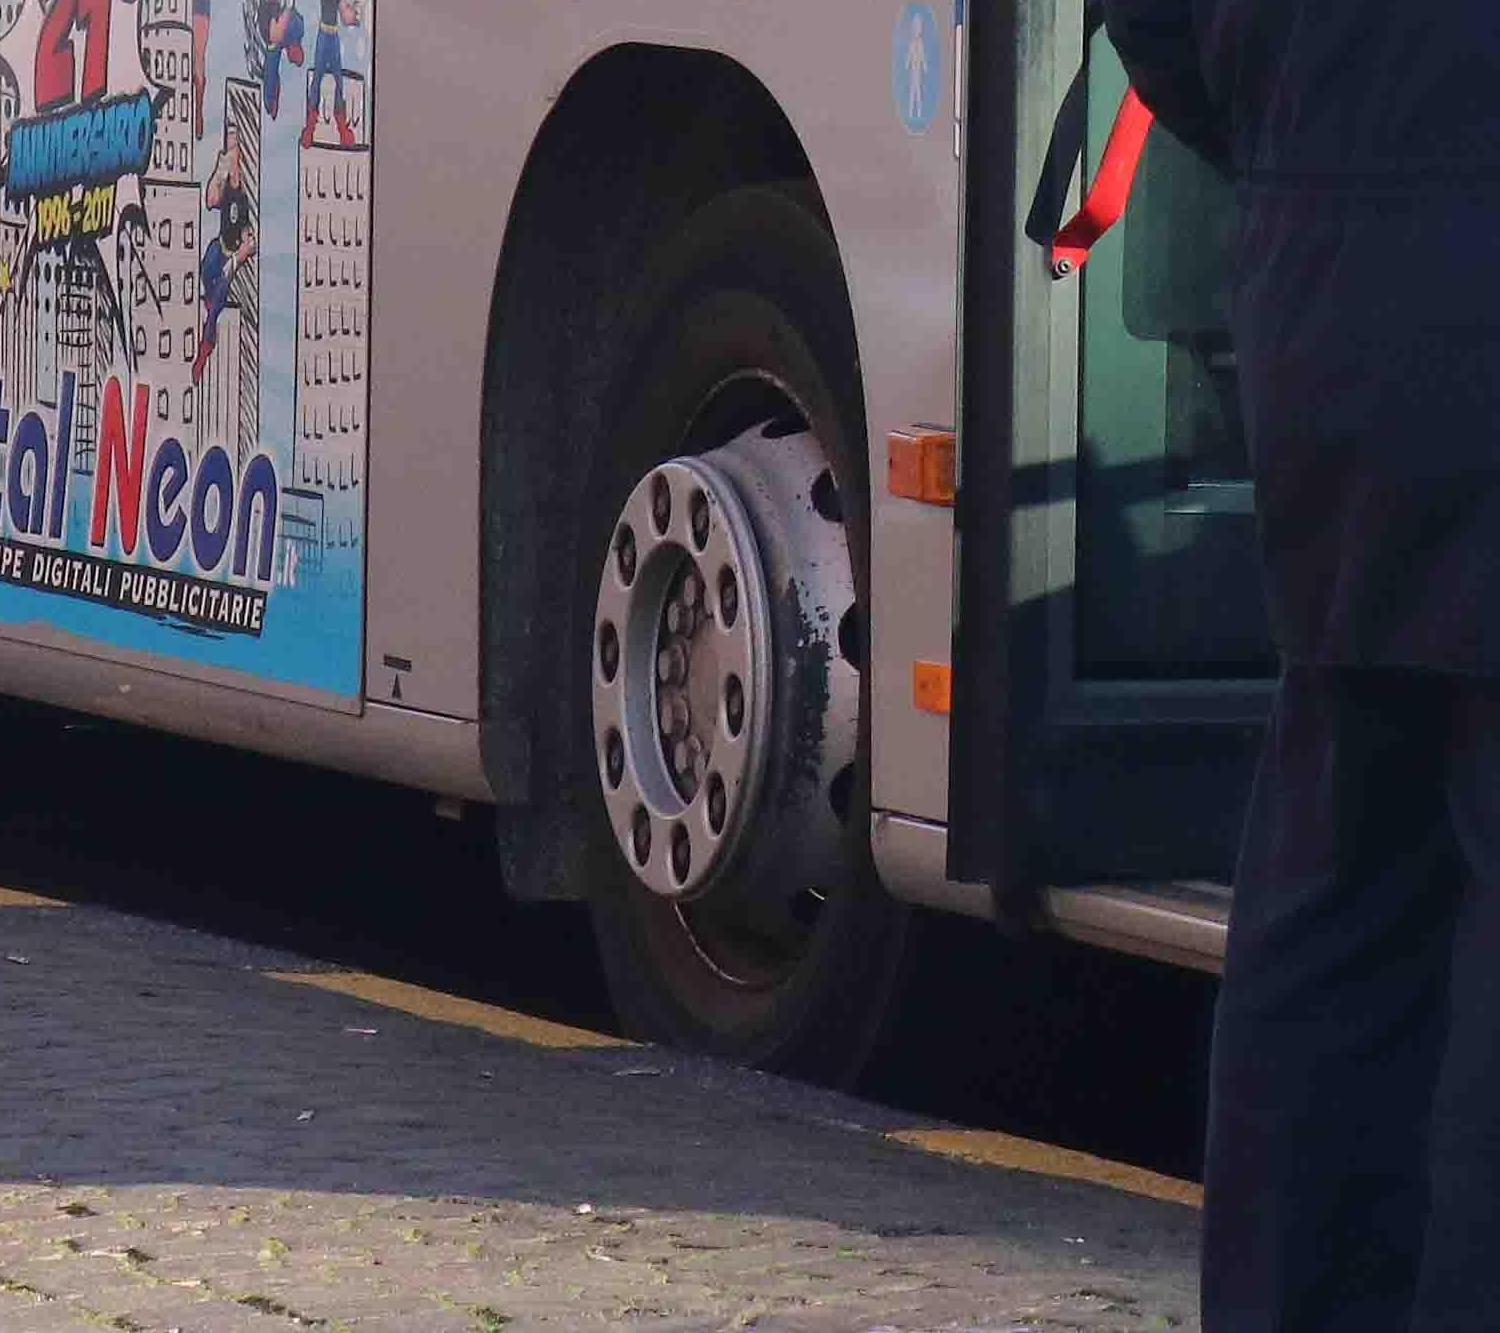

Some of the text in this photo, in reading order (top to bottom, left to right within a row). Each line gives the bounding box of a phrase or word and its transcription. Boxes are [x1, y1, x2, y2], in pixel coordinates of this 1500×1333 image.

[90, 374, 281, 583] Neon
[33, 555, 112, 597] DIGITALI
[119, 571, 264, 630] PUBBLICITARIE
